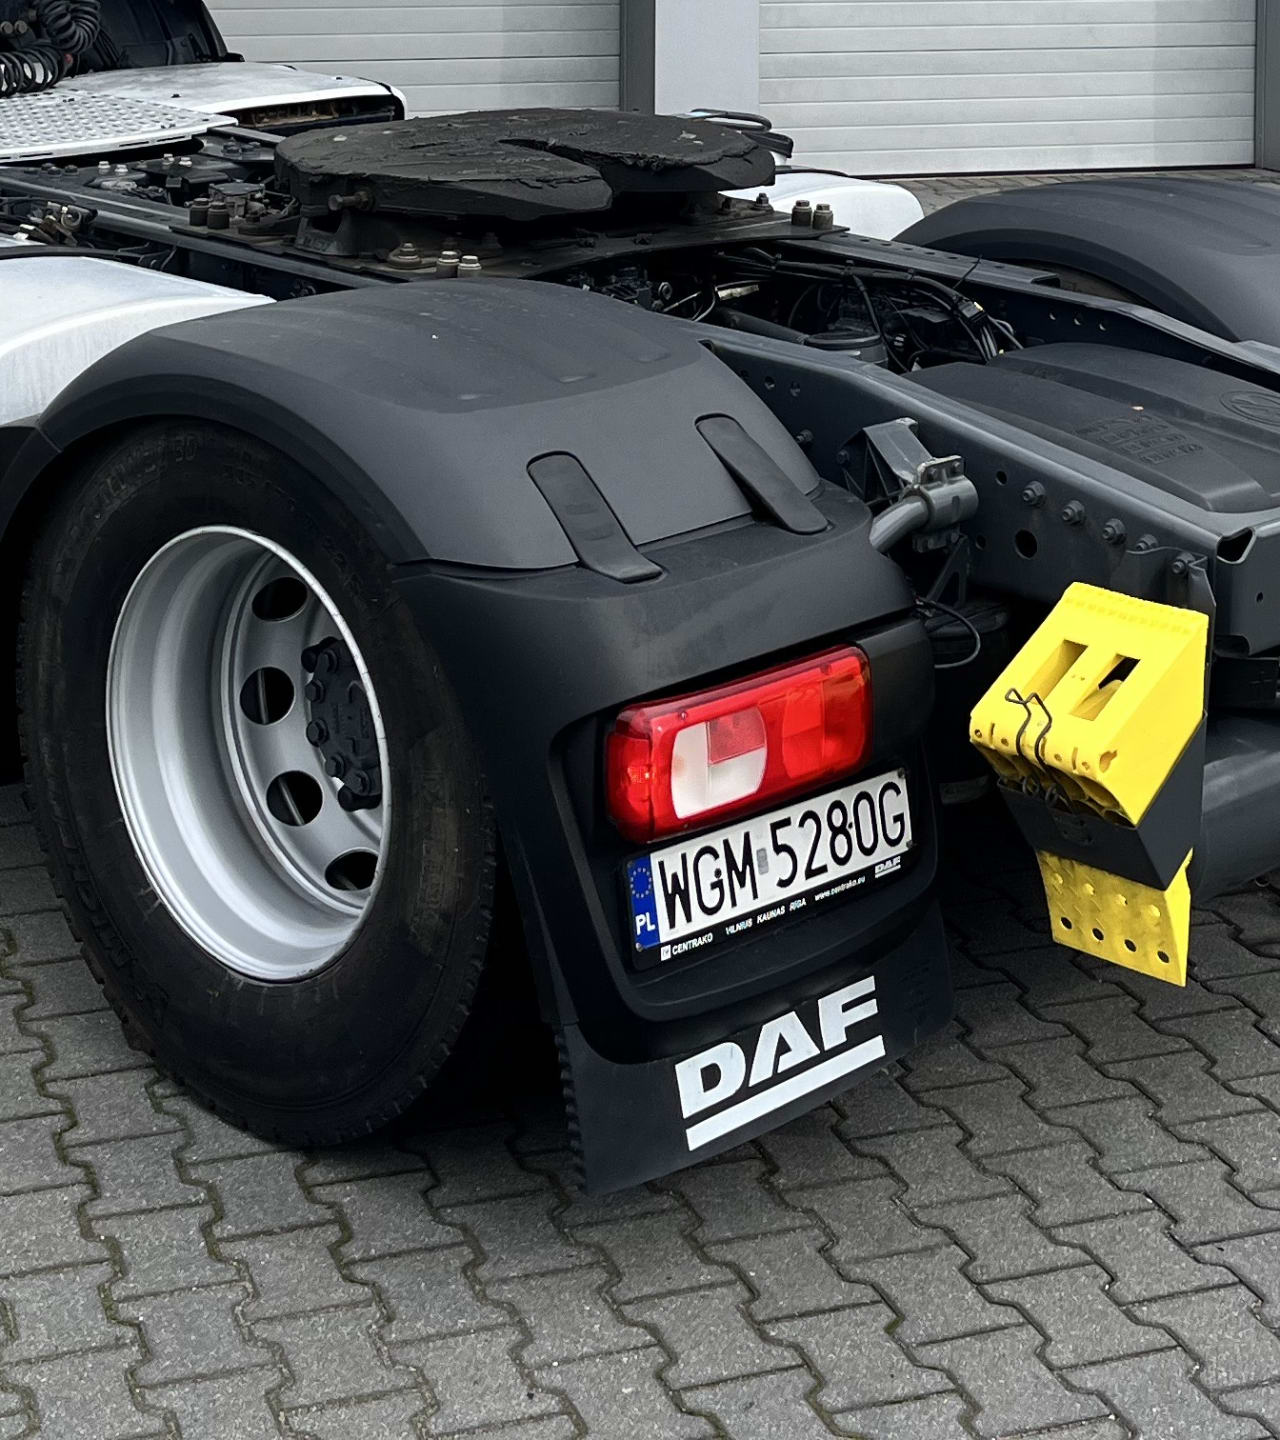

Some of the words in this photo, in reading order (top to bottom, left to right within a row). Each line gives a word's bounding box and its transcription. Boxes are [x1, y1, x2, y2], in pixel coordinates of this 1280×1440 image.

[657, 830, 759, 930] WGM
[769, 780, 906, 889] 5280G
[671, 932, 714, 956] CENTRAKO
[756, 905, 786, 924] KAUNAS
[874, 855, 901, 875] DAF
[634, 911, 656, 937] PL
[674, 975, 878, 1120] DAF
